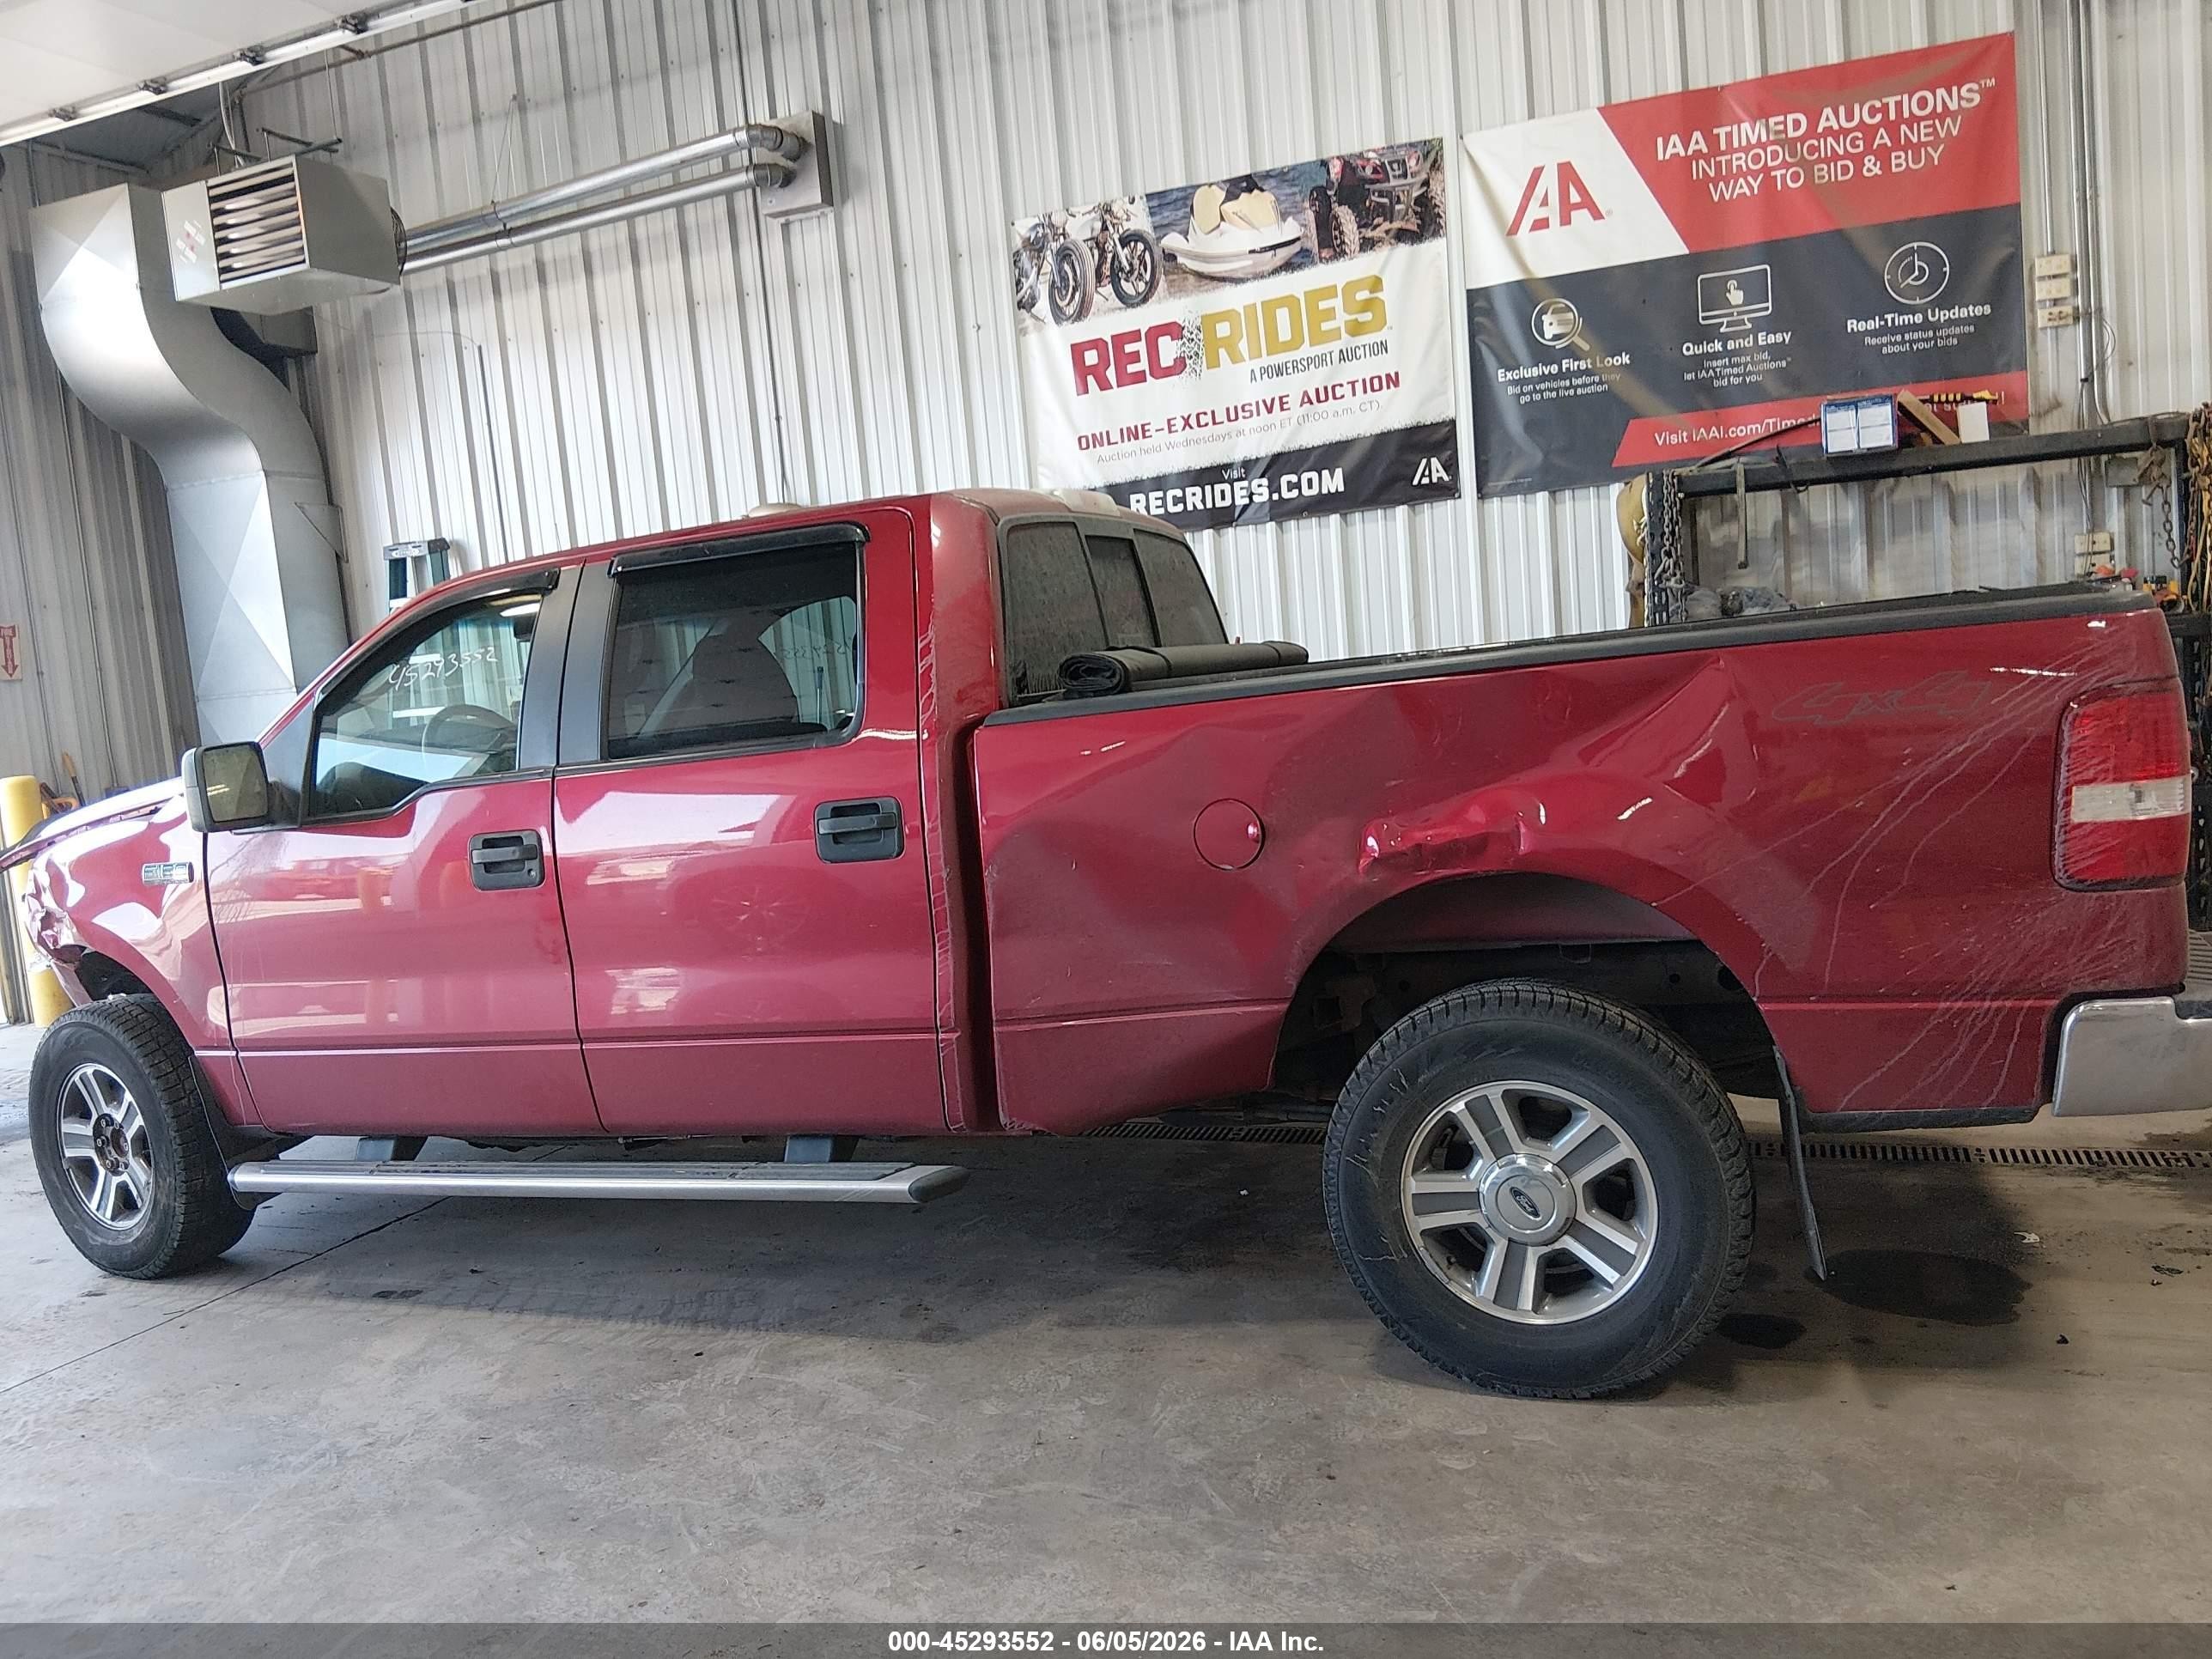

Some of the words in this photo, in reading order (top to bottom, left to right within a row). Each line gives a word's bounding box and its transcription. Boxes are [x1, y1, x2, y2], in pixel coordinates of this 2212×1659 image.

[1656, 130, 1708, 161] IAA
[1712, 112, 1808, 150] TIMED
[1691, 130, 1864, 181] INTRODUCING
[1872, 126, 1893, 149] A
[1899, 115, 1963, 144] NEW
[1708, 173, 1765, 203] WAY
[1770, 167, 1805, 191] TO
[1814, 159, 1855, 185] BID
[1862, 155, 1882, 177] &
[1890, 143, 1946, 173] BUY
[1846, 312, 1923, 333] Real-Time
[1927, 304, 1992, 324] Updates
[1070, 321, 1187, 396] REC
[1202, 274, 1388, 369] RIDES
[1682, 338, 1723, 356] Quick
[1727, 333, 1753, 350] and
[1757, 331, 1792, 346] Easy
[1864, 333, 1902, 346] Receive
[1904, 329, 1934, 341] status
[1936, 325, 1975, 337] updates
[1881, 343, 1911, 355] about
[1911, 341, 1935, 353] your
[1936, 337, 1958, 348] bids
[1250, 368, 1258, 384] A
[1260, 349, 1335, 382] POWERSPORT
[1338, 339, 1389, 365] AUCTION
[1497, 362, 1559, 383] Exclusive
[1561, 357, 1593, 373] First
[1595, 351, 1631, 368] Look
[1683, 371, 1696, 381] let
[1697, 369, 1715, 380] IAA
[1716, 364, 1744, 377] Timed
[1704, 357, 1729, 369] Insert
[1731, 356, 1752, 366] max
[1753, 350, 1771, 362] bid,
[1507, 386, 1521, 396] Bid
[1522, 384, 1534, 392] on
[1534, 378, 1571, 391] vehicles
[1571, 374, 1600, 386] before
[1601, 373, 1621, 383] they
[1519, 395, 1531, 405] go
[1532, 392, 1541, 402] to
[1543, 390, 1557, 400] the
[1559, 387, 1575, 398] live
[1577, 383, 1608, 395] auction
[1713, 378, 1729, 388] bid
[1729, 376, 1743, 386] for
[1744, 374, 1763, 386] you
[1077, 393, 1291, 451] ONLINE-EXCLUSIVE
[1298, 371, 1401, 408] AUCTION
[1097, 447, 1137, 465] Auction
[1139, 444, 1162, 457] held
[1164, 430, 1233, 452] Wednesdays
[1236, 427, 1247, 438] at
[1249, 422, 1277, 434] noon
[1279, 417, 1292, 430] ET
[1296, 410, 1329, 428] (11:00
[1332, 405, 1356, 419] a.m.
[1655, 429, 1688, 447] Visit
[1221, 468, 1246, 481] Visit
[1129, 467, 1345, 515] RECRIDES.COM
[388, 646, 499, 691] 45293552
